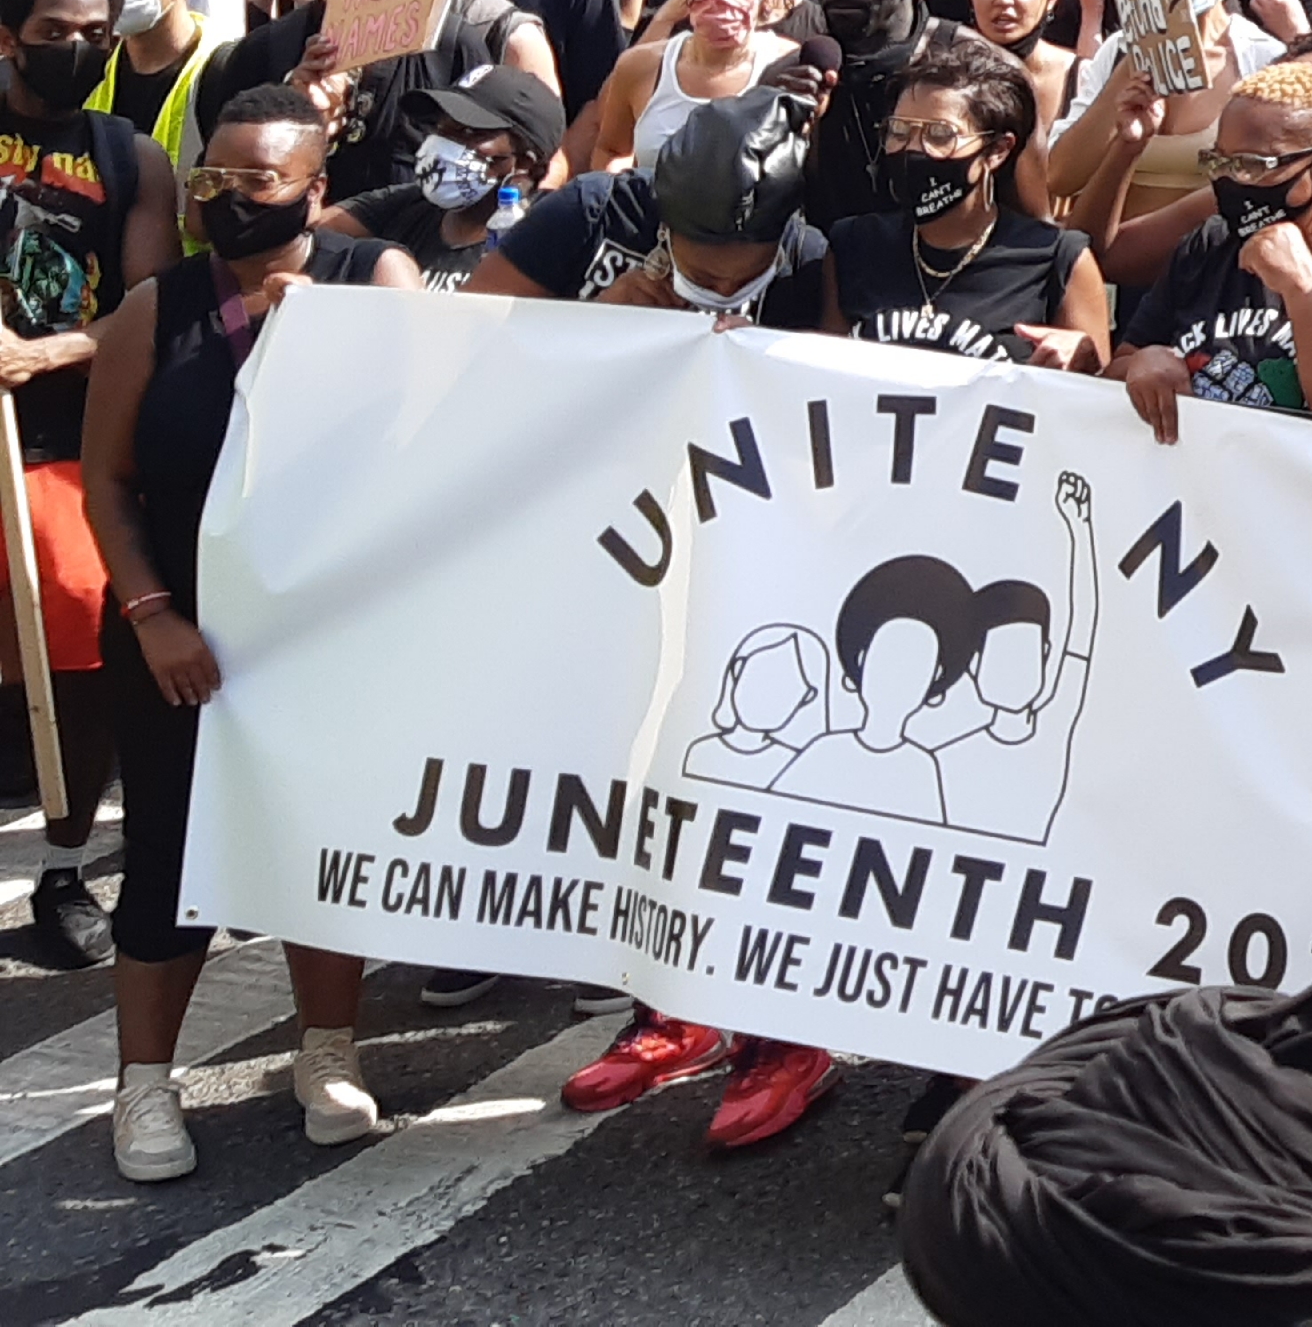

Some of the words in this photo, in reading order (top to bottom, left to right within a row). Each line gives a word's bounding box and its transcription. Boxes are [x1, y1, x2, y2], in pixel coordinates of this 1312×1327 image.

[930, 177, 937, 187] I
[916, 189, 963, 217] BREATHE
[1244, 200, 1253, 211] I
[1215, 308, 1279, 338] LIVES
[597, 394, 1037, 589] UNITE
[1118, 499, 1286, 689] NY
[392, 757, 1094, 961] JUNETEENTH
[317, 847, 376, 909] WE
[381, 857, 467, 922] CAN
[476, 869, 604, 937] MAKE
[610, 885, 716, 976] HISTORY.
[734, 924, 811, 993] WE
[813, 942, 928, 1015] JUST
[931, 963, 1055, 1041] HAVE
